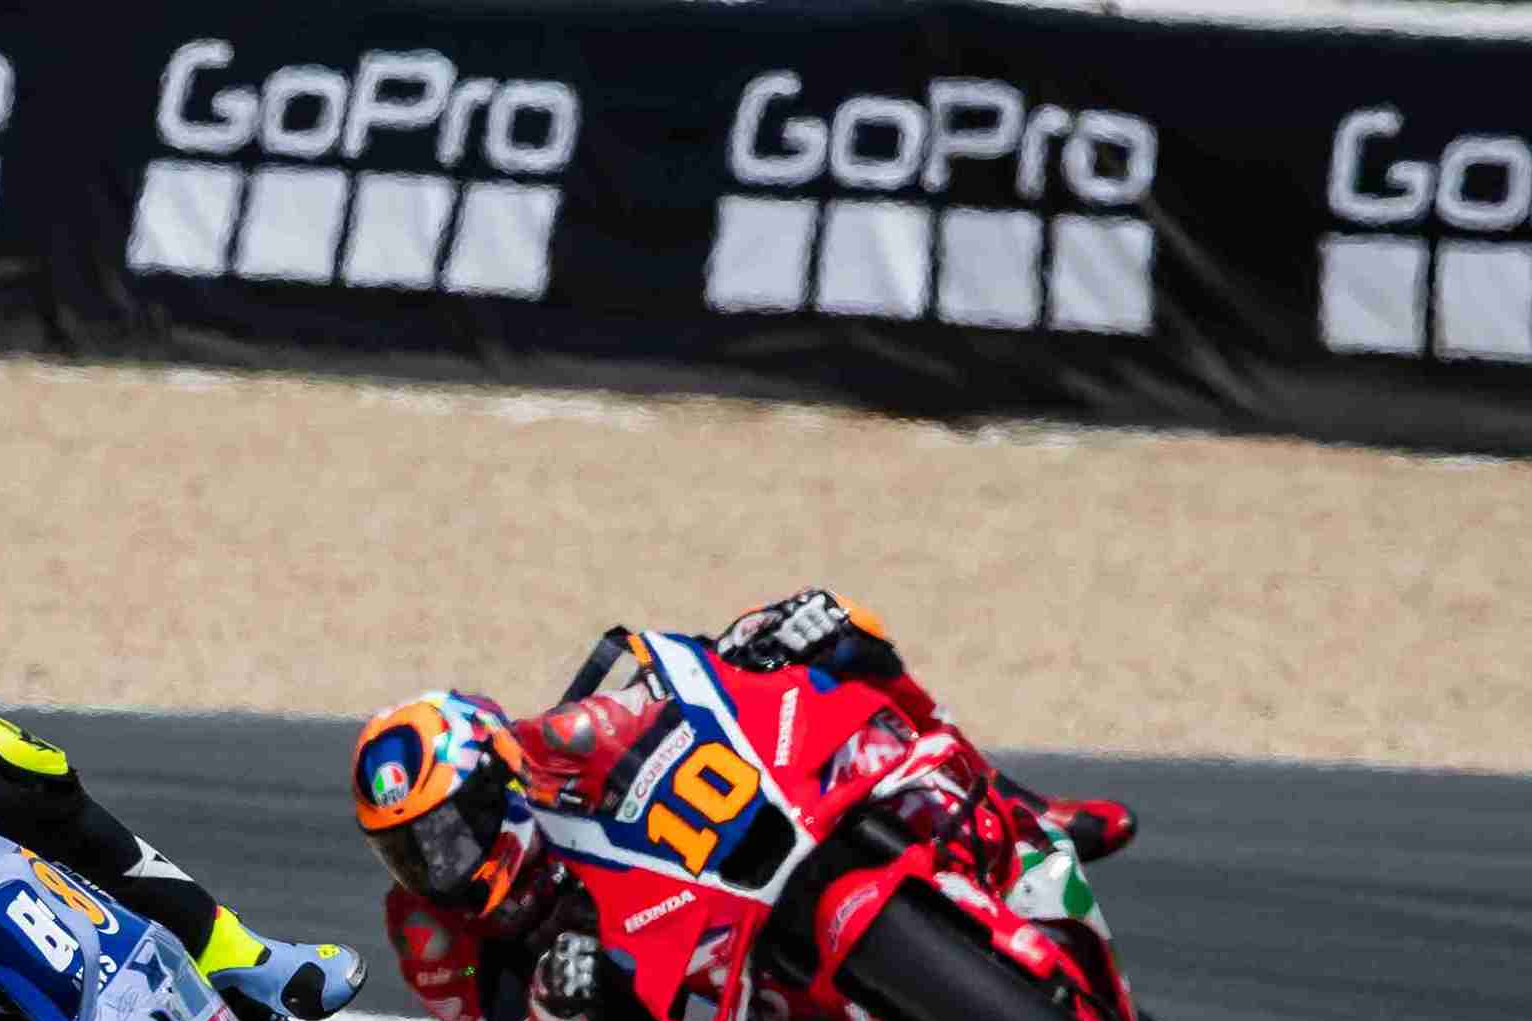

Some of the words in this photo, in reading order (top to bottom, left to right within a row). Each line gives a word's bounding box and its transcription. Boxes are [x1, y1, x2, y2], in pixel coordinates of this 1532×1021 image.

[156, 37, 580, 174] GoPro
[725, 69, 1159, 203] GoPro
[1326, 103, 1532, 233] Go
[646, 740, 761, 879] 10
[624, 889, 697, 934] HONDA
